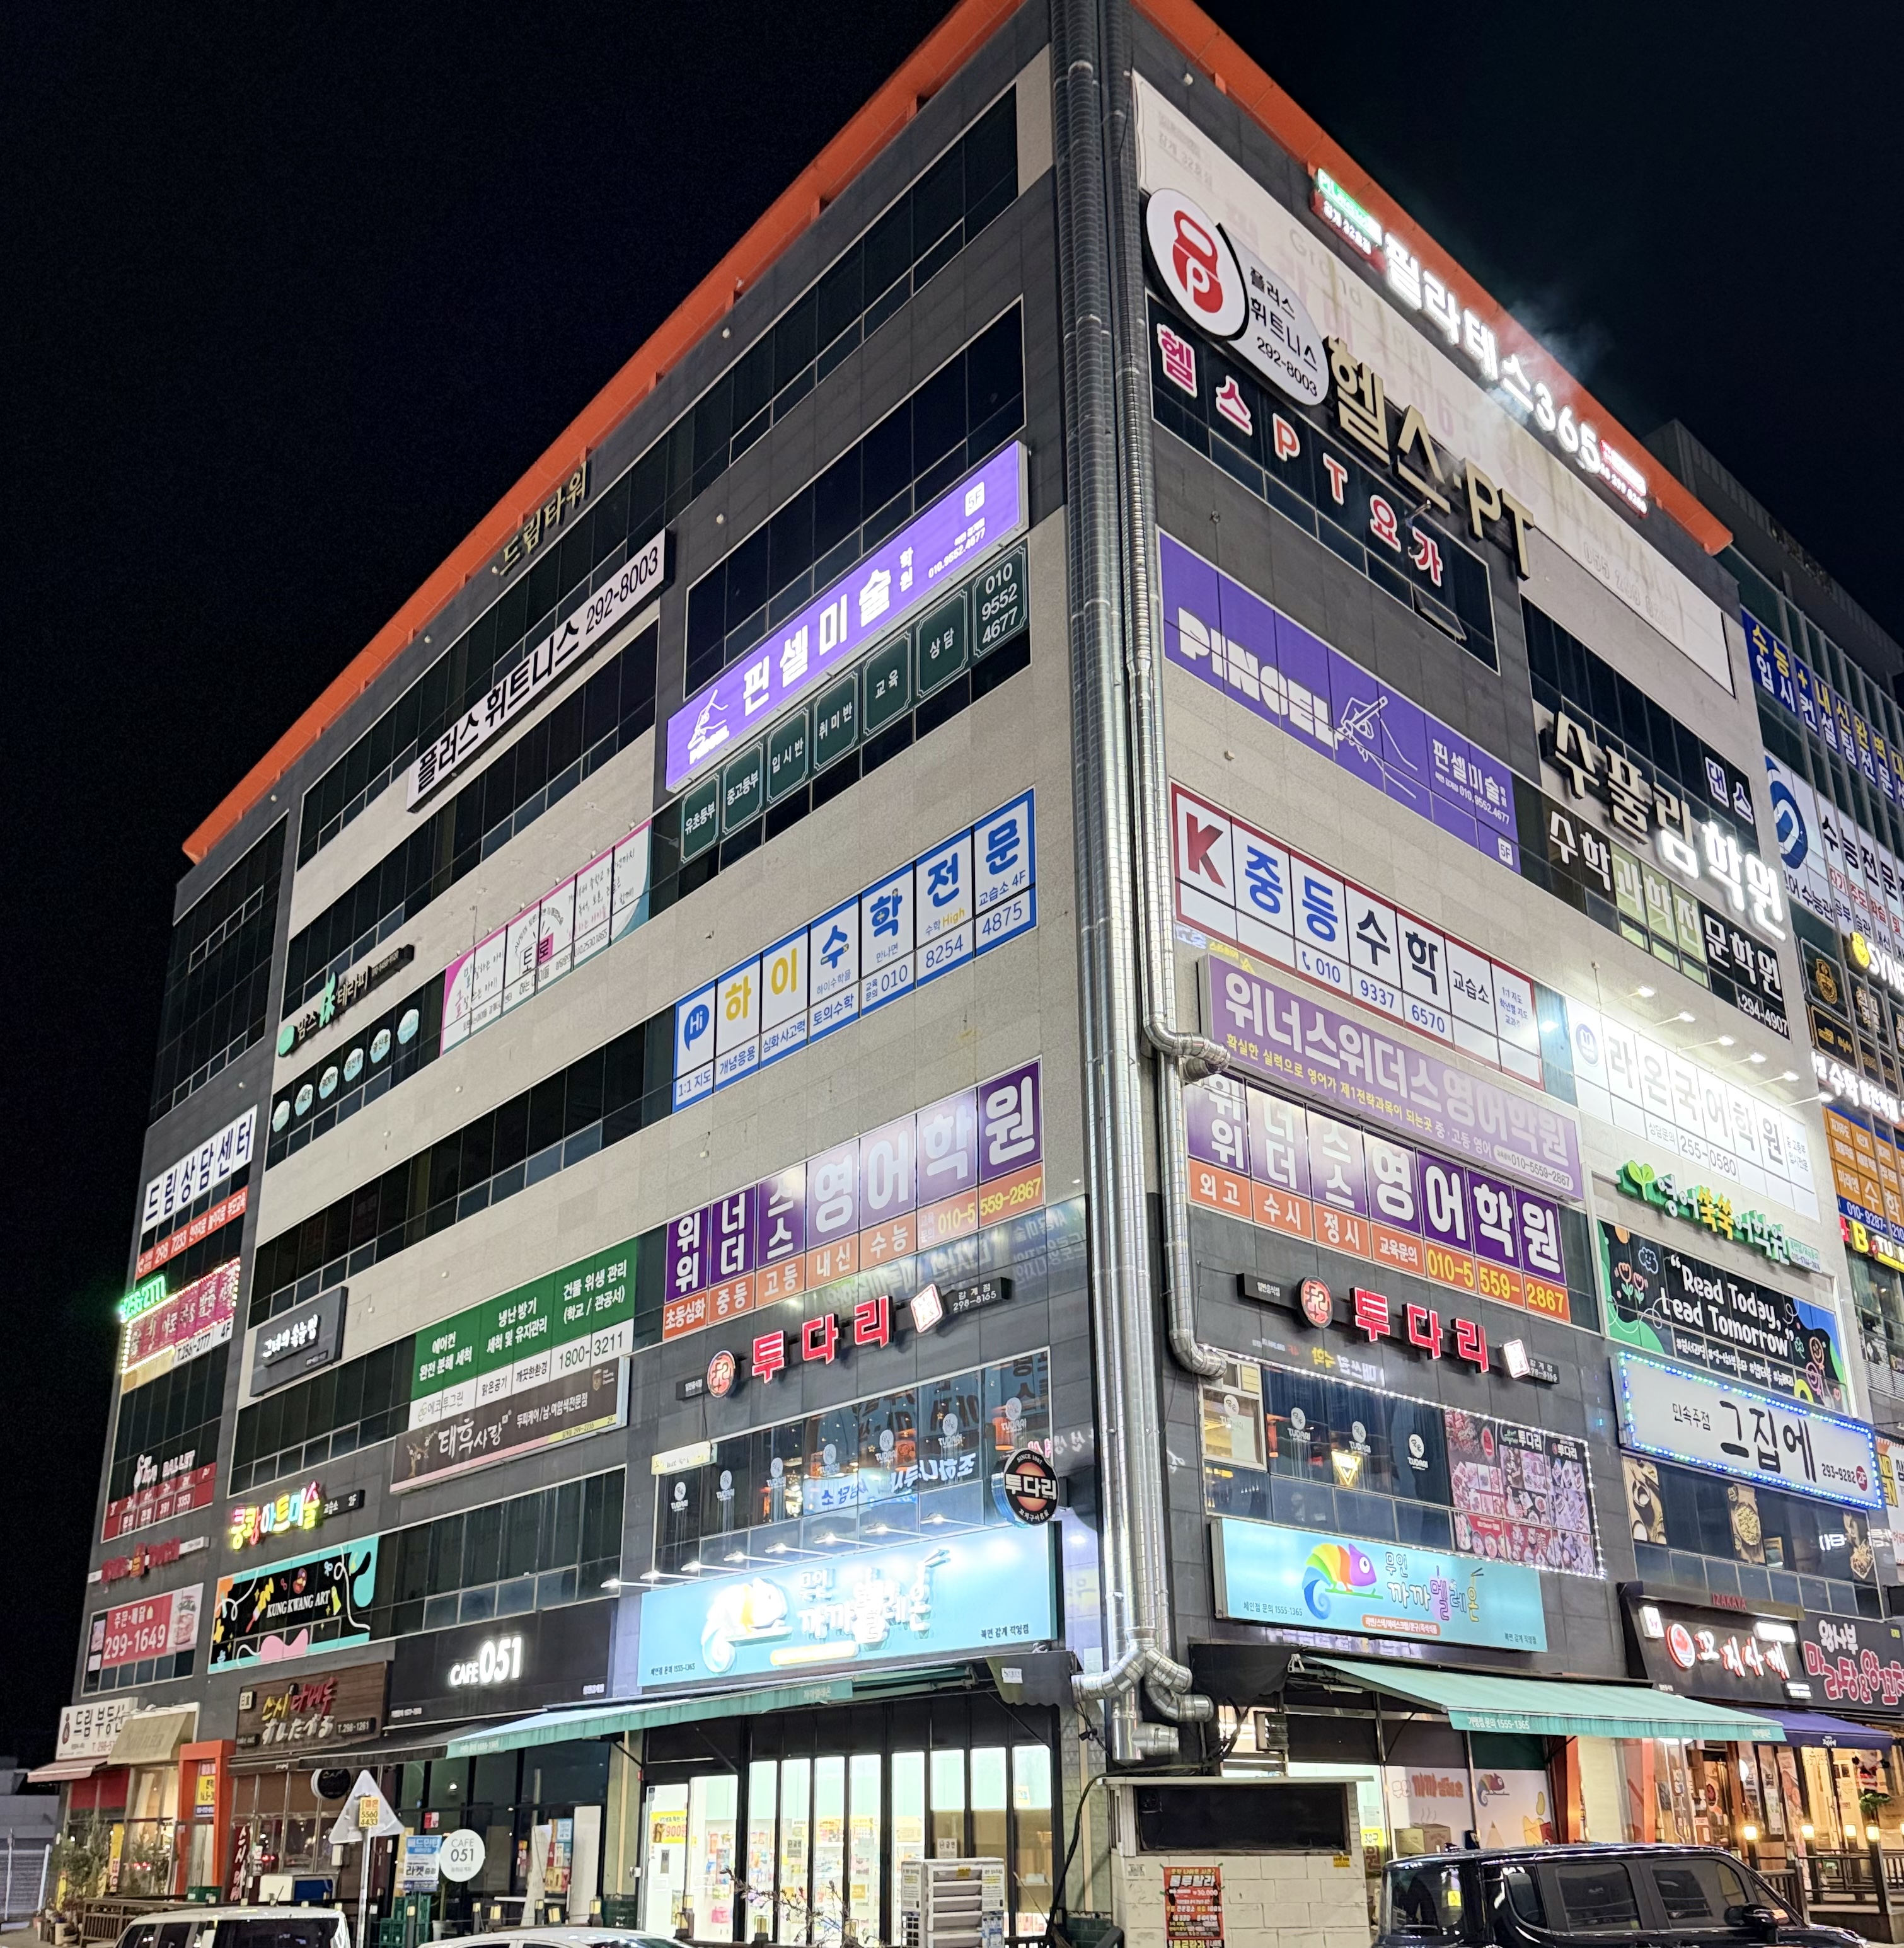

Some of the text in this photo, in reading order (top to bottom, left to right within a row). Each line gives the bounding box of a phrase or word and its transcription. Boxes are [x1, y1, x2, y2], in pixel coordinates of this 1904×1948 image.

[1250, 266, 1296, 320] 플러스
[1250, 297, 1317, 372] 휘트니스
[1385, 231, 1603, 474] 필라테스365
[1256, 336, 1318, 397] 292-8003
[1157, 323, 1253, 436] 헬스
[1369, 494, 1443, 587] 요가
[500, 460, 589, 577] 드림타워
[927, 526, 986, 579] 010.9552.4677
[585, 546, 659, 634] 292-8003
[981, 582, 1018, 622] 9552
[742, 567, 891, 717] 핀셀미술
[981, 606, 1018, 646] 4677
[1751, 624, 1791, 679] 수능
[684, 797, 715, 836] 유초등부
[726, 771, 759, 807] 중고등부
[771, 737, 804, 773] 입시반
[819, 701, 853, 740] 취미반
[874, 669, 899, 700] 교육
[929, 626, 955, 660] 상담
[984, 562, 1013, 595] 010
[1755, 655, 1797, 713] 입시
[1432, 738, 1500, 807] 핀셀미술
[1705, 756, 1754, 825] 댄스
[1458, 787, 1511, 824] 010.9552.4677
[1555, 710, 1787, 942] 수풀림학원
[1499, 841, 1512, 861] 5F
[875, 942, 899, 963] 만나면
[925, 918, 941, 937] 수학
[942, 908, 966, 930] High
[979, 882, 1010, 907] 교습소
[1011, 870, 1026, 887] 4F
[1186, 811, 1226, 889] K
[1453, 969, 1490, 1006] 교습소
[337, 970, 368, 1007] 테라피
[678, 900, 1022, 1097] 1:1 지도 개념응용 심화 사고력 토의수학 교육 010 8254 4875
[865, 988, 879, 1003] 문의
[1315, 957, 1446, 1034] 010 9337 6570
[1511, 990, 1523, 1005] 지도
[689, 1010, 704, 1034] Hi
[1741, 994, 1789, 1037] 294-4907
[1226, 1033, 1492, 1158] 확실한 실력으로 영어가 제1전략과목이 되는곳 영어
[1608, 1035, 1784, 1166] 라온국어학원
[145, 1113, 253, 1222] 드림상담센터
[814, 1076, 1036, 1234] 영어학원
[1510, 1153, 1571, 1188] 010-5559-2867
[1648, 1122, 1737, 1177] 상담문의 255-0580
[1199, 1173, 1419, 1266] 외고 수시 정시 교육문의
[1373, 1146, 1562, 1276] 영어학원
[1864, 1178, 1901, 1224] 수학
[563, 1259, 627, 1301] 건물 위생 관리
[664, 1301, 707, 1332] 초등심화
[716, 1282, 748, 1315] 중등
[763, 1262, 798, 1298] 고등
[815, 1244, 851, 1278] 내신
[870, 1222, 909, 1259] 수능
[958, 1282, 993, 1300] 감계점
[497, 1298, 538, 1328] 냉난방기
[563, 1285, 626, 1325] (학교 관공서)
[952, 1289, 998, 1312] 298-8165
[1659, 1287, 1704, 1328] Lead
[1727, 1290, 1782, 1332] Today,
[221, 1321, 231, 1337] 4F
[432, 1330, 456, 1354] 에어컨
[486, 1315, 548, 1354] 세척 및 유지관리
[751, 1294, 891, 1384] 투다리
[1352, 1286, 1490, 1374] 투다리
[419, 1345, 473, 1382] 완전 분해 세척
[482, 1377, 508, 1397] 맑은공기
[516, 1361, 548, 1384] 깨끗한환경
[558, 1330, 624, 1370] 1800-3211
[1016, 1453, 1032, 1464] SINCE
[1518, 1429, 1543, 1452] 투다리
[1557, 1444, 1578, 1460] 투다리
[1671, 1402, 1712, 1431] 민속주점
[1719, 1399, 1818, 1484] 그집에
[1005, 1473, 1057, 1501] 투다리
[1821, 1462, 1857, 1485] 293-9282
[1385, 1551, 1409, 1578] 무인
[267, 1589, 330, 1618] KUNG KWANG ART
[1243, 1600, 1303, 1618] 체인점 문의 1555-1365
[1387, 1568, 1480, 1623] 까까멜레온
[1711, 1593, 1747, 1611] IZAKAYA
[103, 1623, 166, 1661] 299-1649
[981, 1622, 1029, 1640] 북면 감계 직영점
[1818, 1619, 1859, 1656] 왕사부
[449, 1635, 523, 1686] CAFE 051
[73, 1709, 94, 1738] 드림
[1497, 1718, 1530, 1731] 1555-1365
[360, 1818, 378, 1826] 4433
[451, 1838, 475, 1848] CAFE
[405, 1865, 424, 1877] 라켓
[450, 1848, 475, 1862] 051
